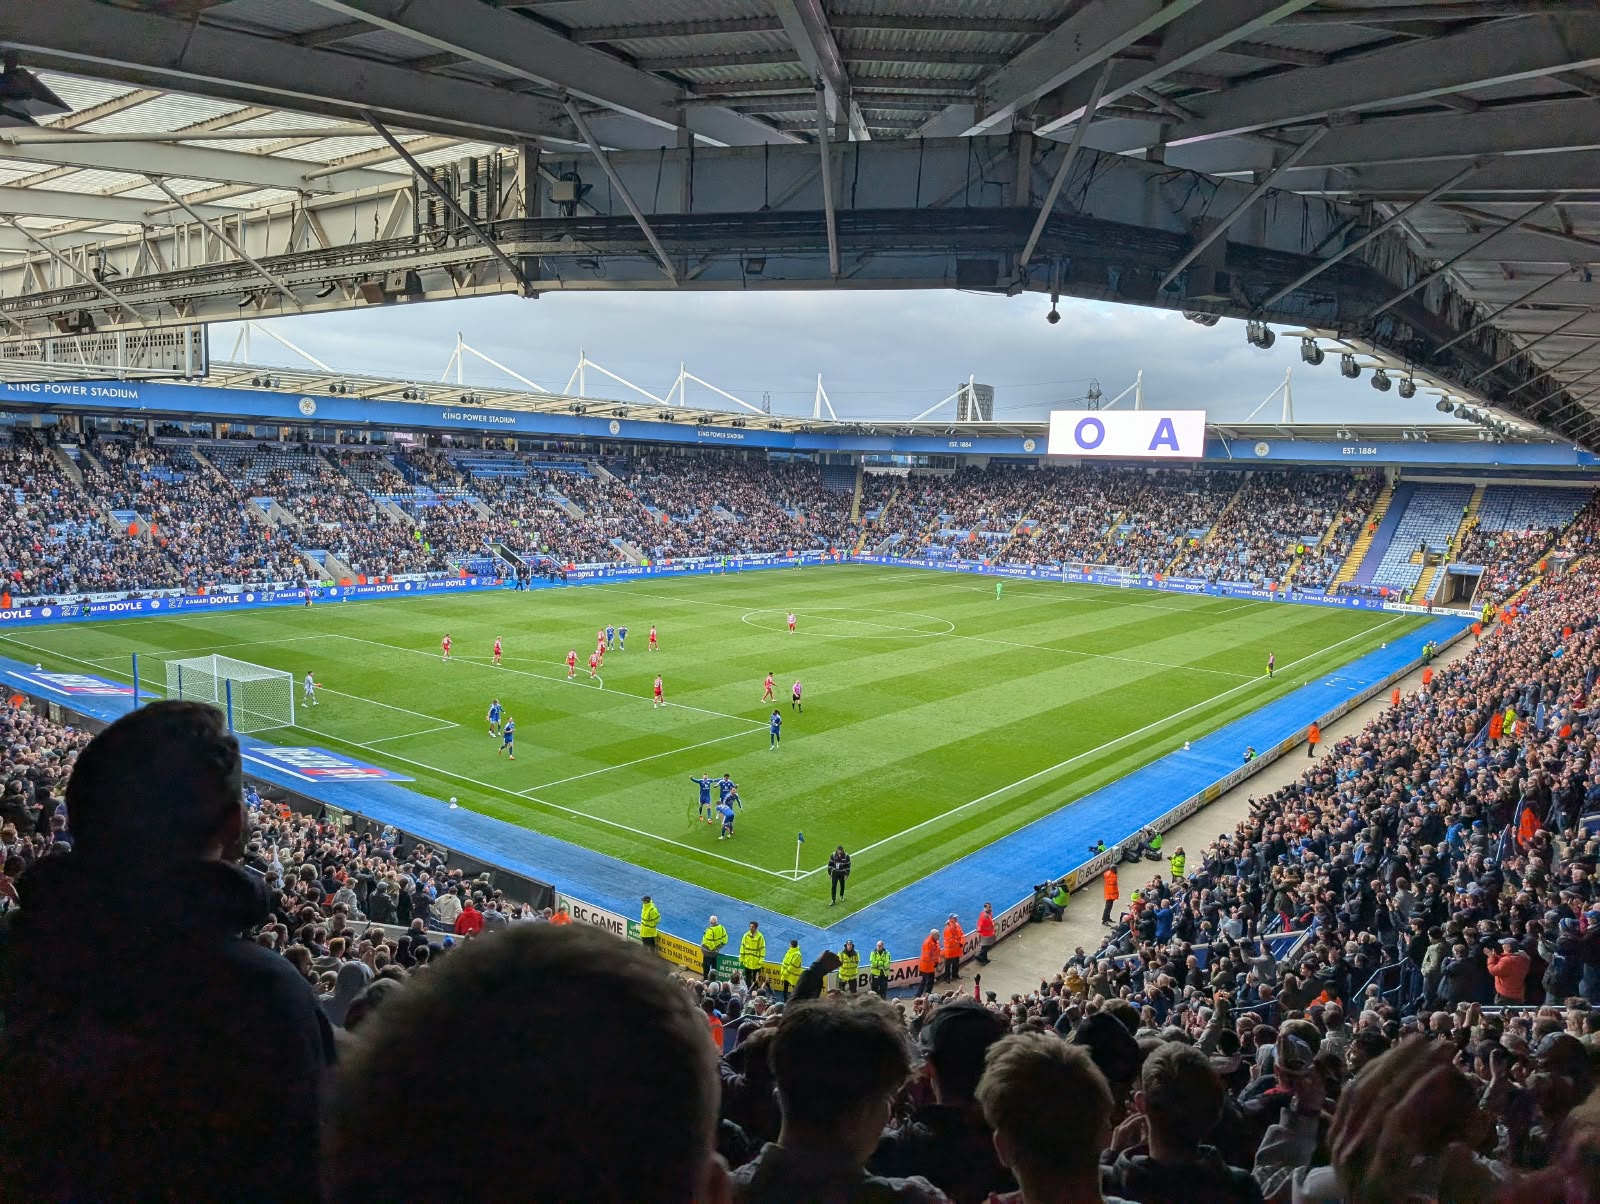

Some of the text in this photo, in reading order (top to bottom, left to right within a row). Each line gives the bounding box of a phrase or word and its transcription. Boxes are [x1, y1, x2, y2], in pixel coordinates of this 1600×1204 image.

[7, 383, 138, 399] KING POWER STADIUM
[442, 412, 516, 424] KING POWER STADIUM
[710, 431, 726, 439] POWER
[1074, 417, 1180, 451] O A
[1359, 447, 1377, 455] 1884
[376, 583, 399, 592] DOYLE
[445, 578, 467, 587] DOYLE
[168, 594, 239, 609] 27 KAMARI DOYLE
[1322, 596, 1347, 605] DOYLE
[61, 605, 80, 617] 27
[109, 601, 142, 611] DOYLE
[573, 905, 623, 936] BC.GAME
[1001, 903, 1034, 933] BC.GAME
[673, 942, 698, 957] ARRESTABLE
